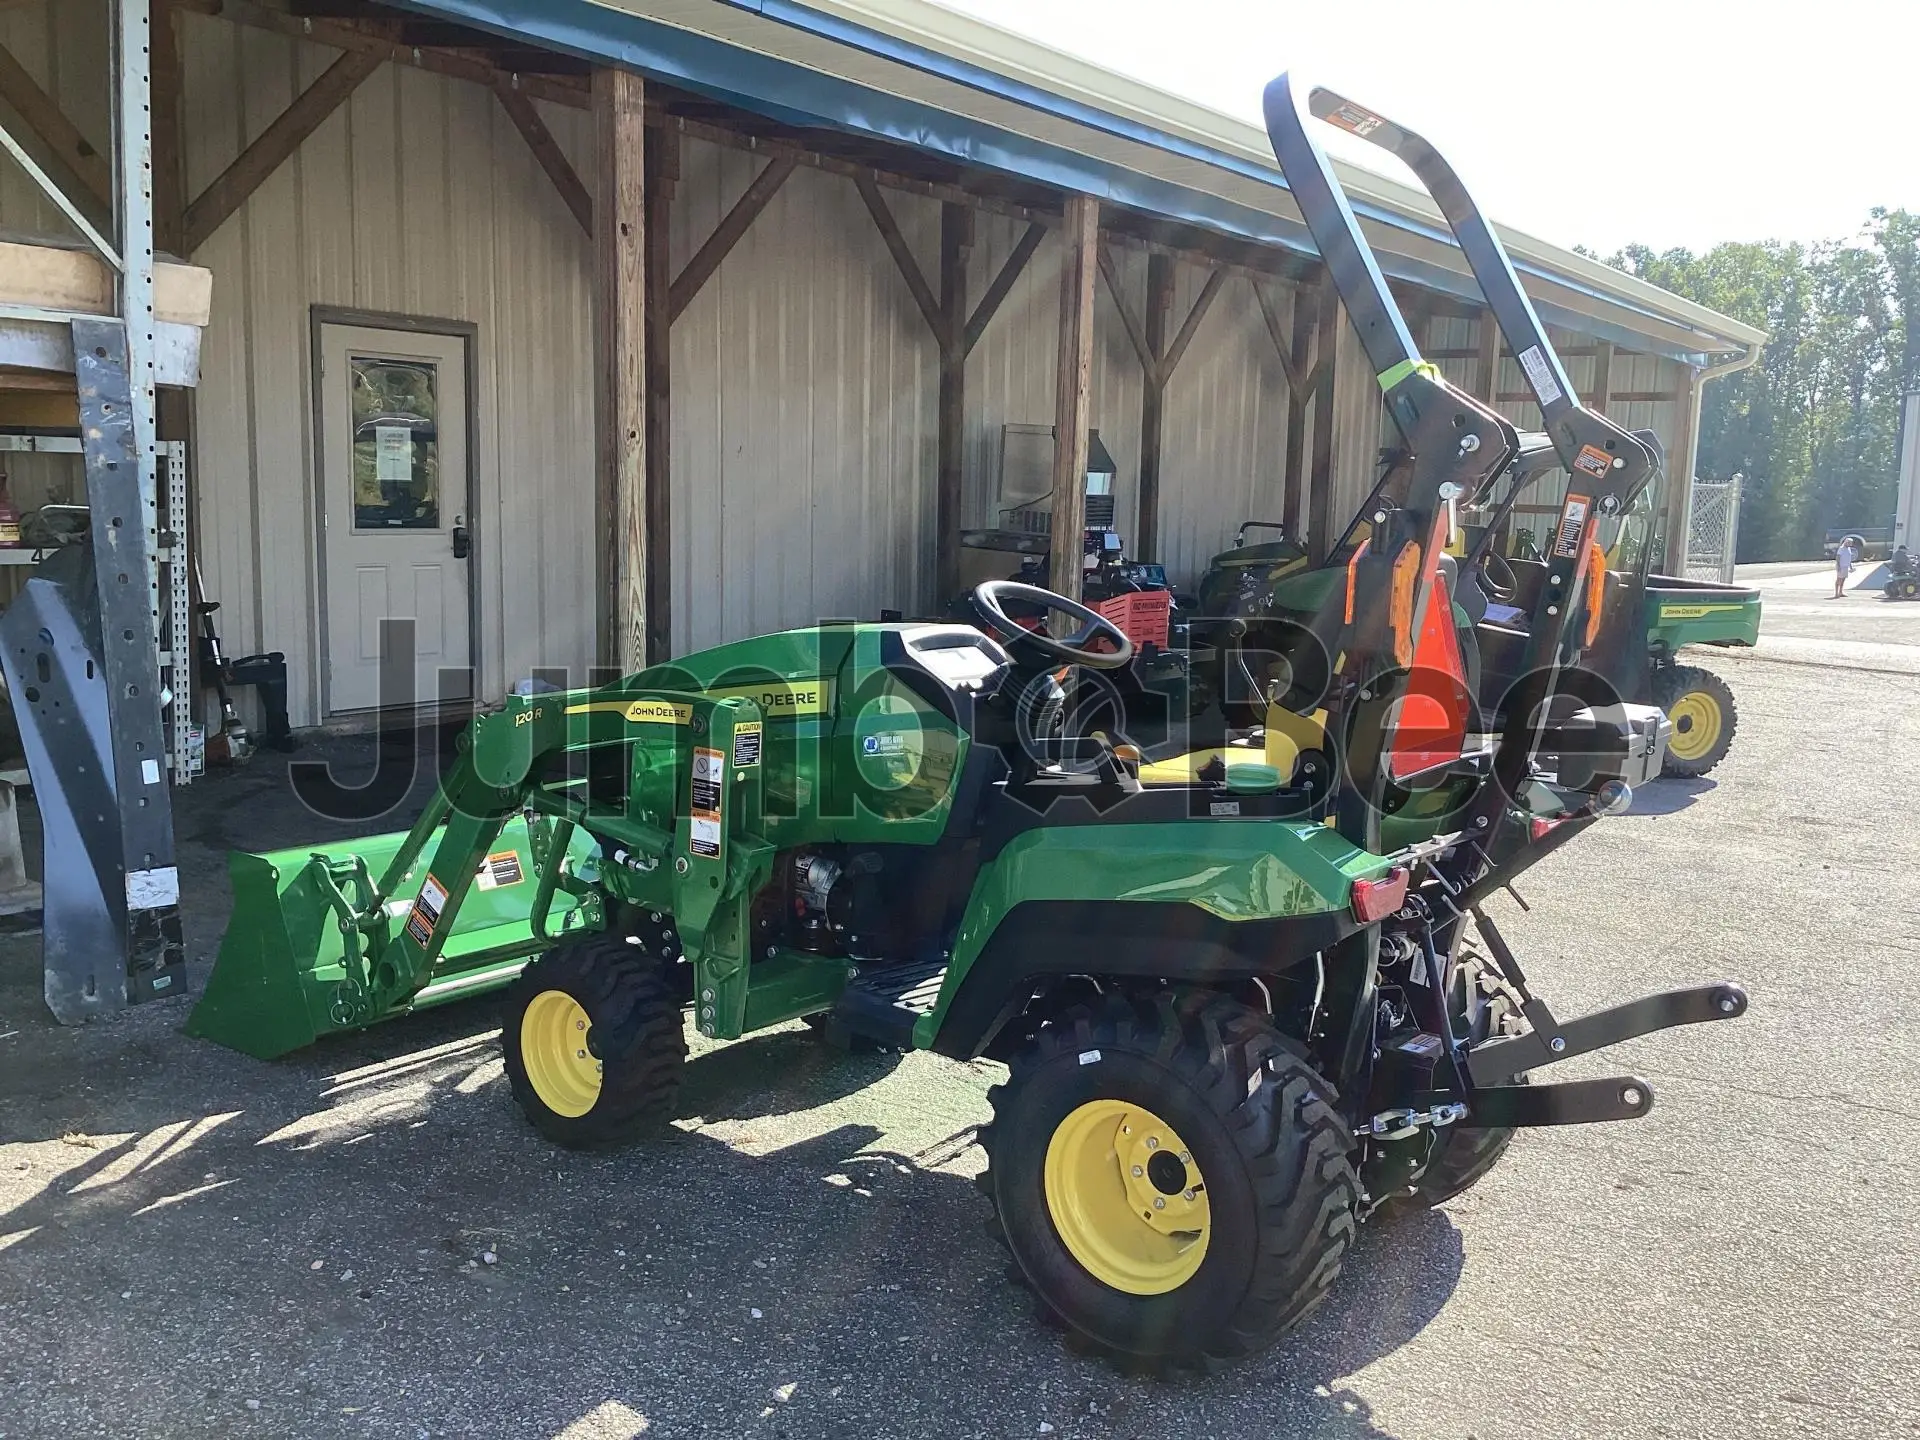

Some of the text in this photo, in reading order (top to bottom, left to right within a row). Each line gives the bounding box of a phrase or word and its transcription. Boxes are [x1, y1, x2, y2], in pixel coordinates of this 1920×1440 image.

[762, 692, 817, 706] DEERE
[631, 706, 686, 718] JOHN DEERE
